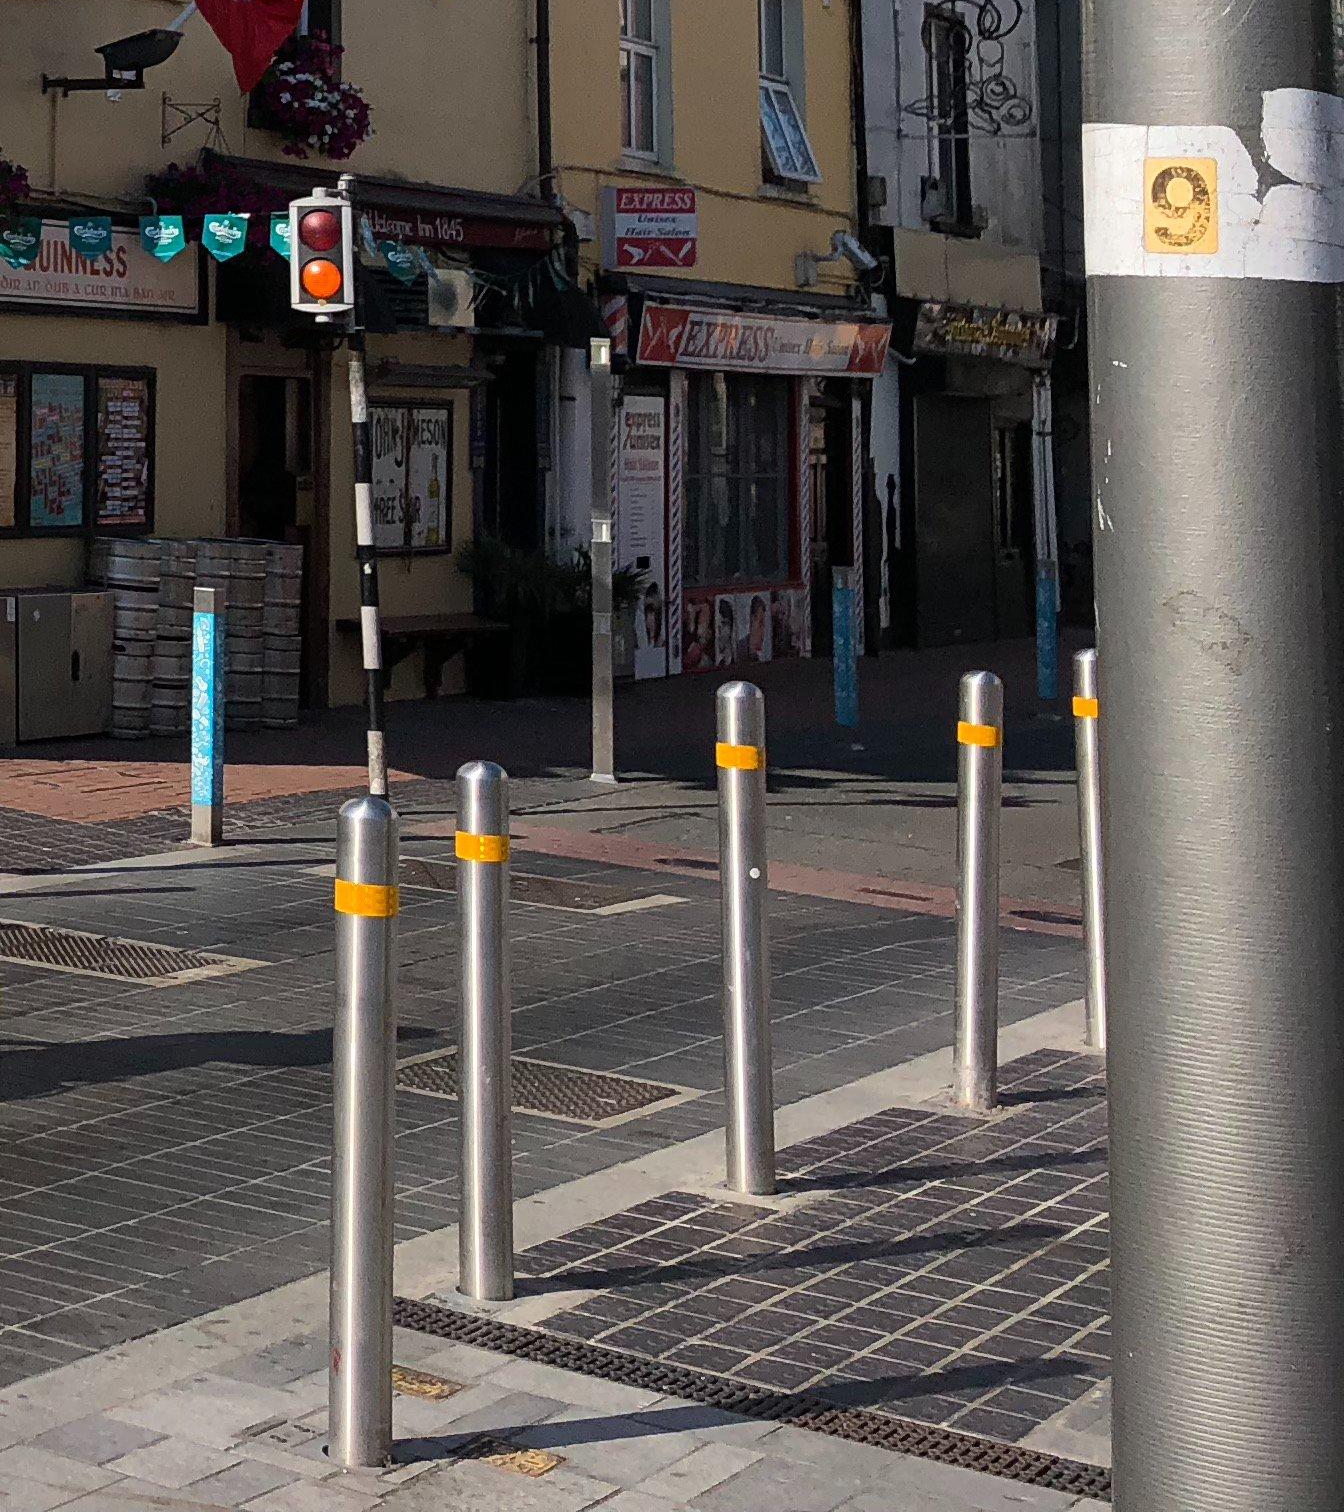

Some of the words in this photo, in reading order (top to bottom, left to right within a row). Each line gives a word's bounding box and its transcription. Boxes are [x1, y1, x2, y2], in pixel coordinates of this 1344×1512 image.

[620, 193, 692, 209] EXPRESS
[1151, 166, 1211, 247] 9
[435, 216, 463, 241] 1845
[624, 228, 653, 236] Hair
[657, 228, 691, 236] Salon
[680, 320, 775, 363] EXPRESS
